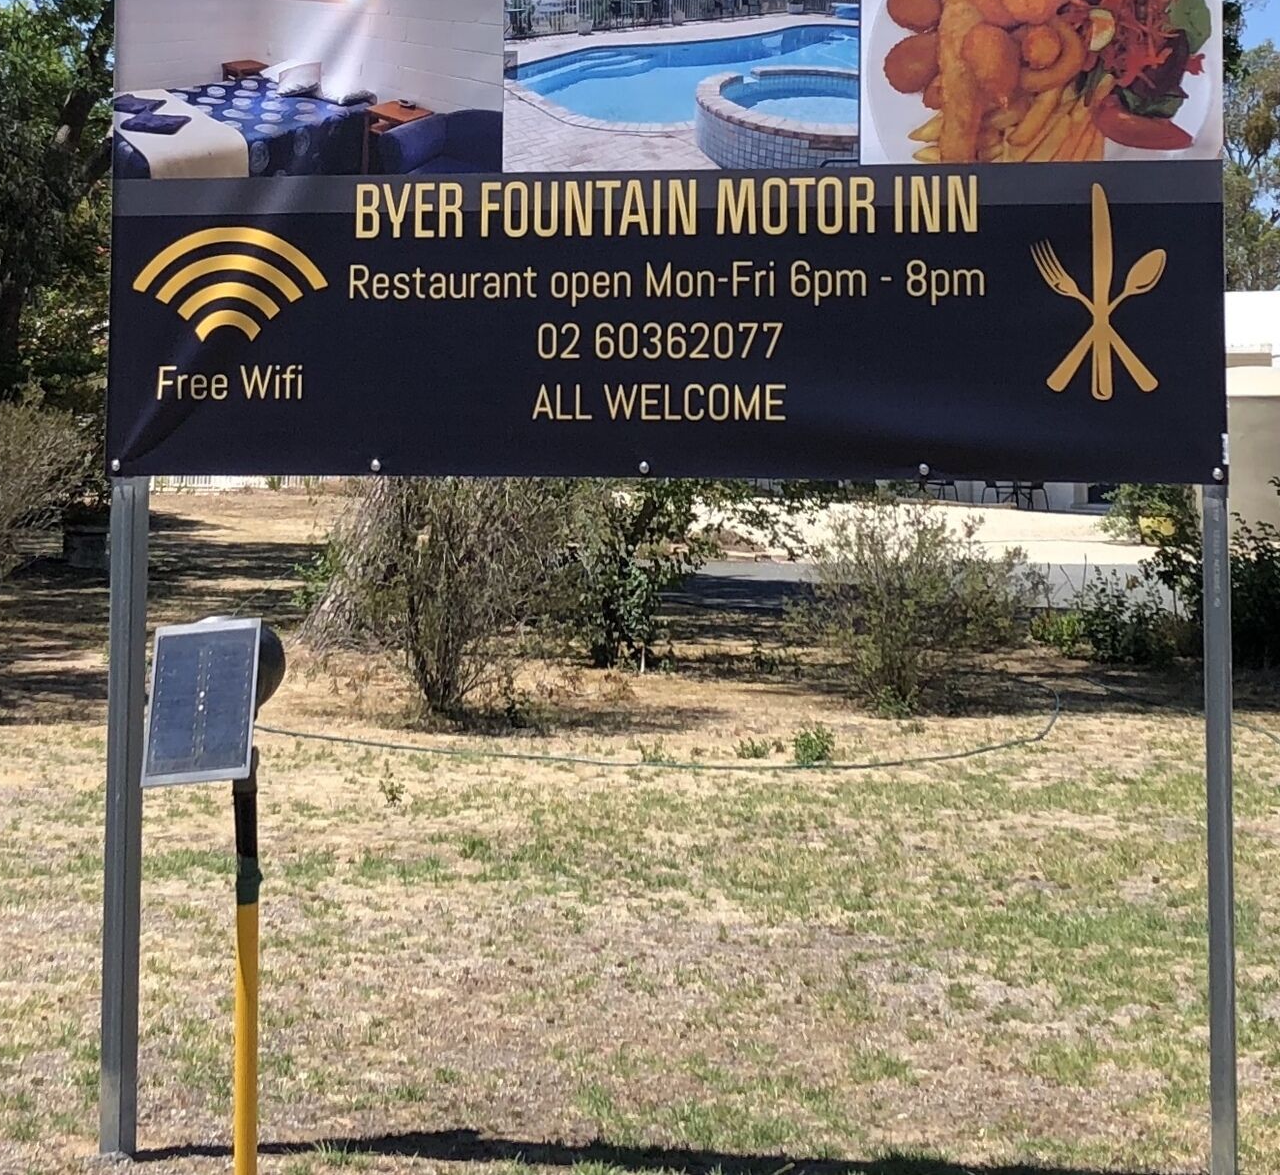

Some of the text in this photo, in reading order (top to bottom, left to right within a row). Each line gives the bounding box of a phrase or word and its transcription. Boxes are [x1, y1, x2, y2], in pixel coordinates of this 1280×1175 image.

[355, 174, 978, 239] BYER FOUNTAIN MOTOR INN
[350, 265, 537, 299] Restaurant
[551, 273, 631, 306] open
[646, 261, 777, 298] Mon-Fri
[790, 260, 867, 306] 6pm
[907, 259, 986, 305] 8pm
[538, 322, 784, 359] 02 60362077
[157, 366, 303, 400] Free Wifi
[532, 383, 787, 422] ALL WELCOME
